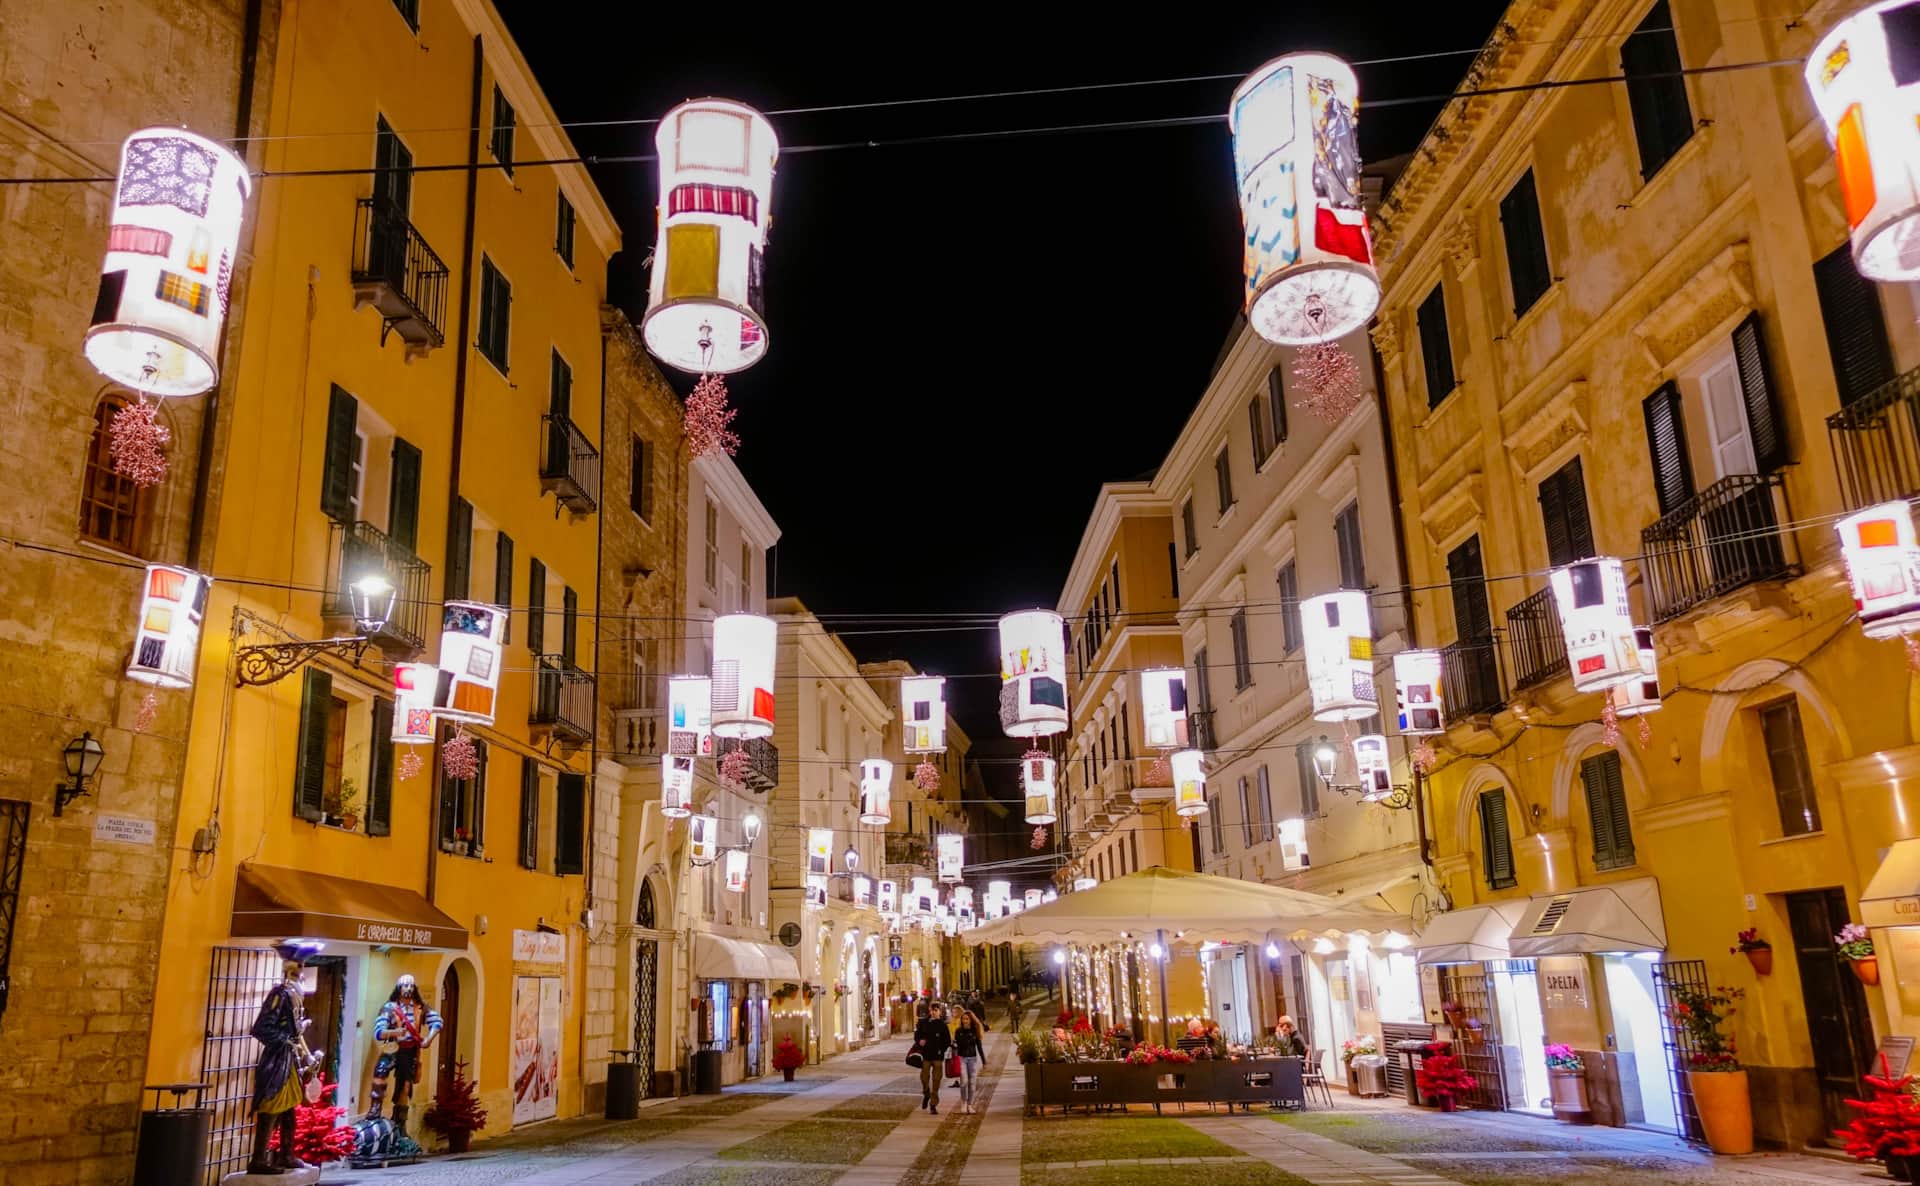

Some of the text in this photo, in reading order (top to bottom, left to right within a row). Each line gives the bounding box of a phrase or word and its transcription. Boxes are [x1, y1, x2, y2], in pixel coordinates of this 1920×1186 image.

[357, 923, 367, 939] LE
[367, 924, 402, 941] CARAMELLE
[403, 928, 413, 944] DEI
[1547, 975, 1580, 990] SPELTA
